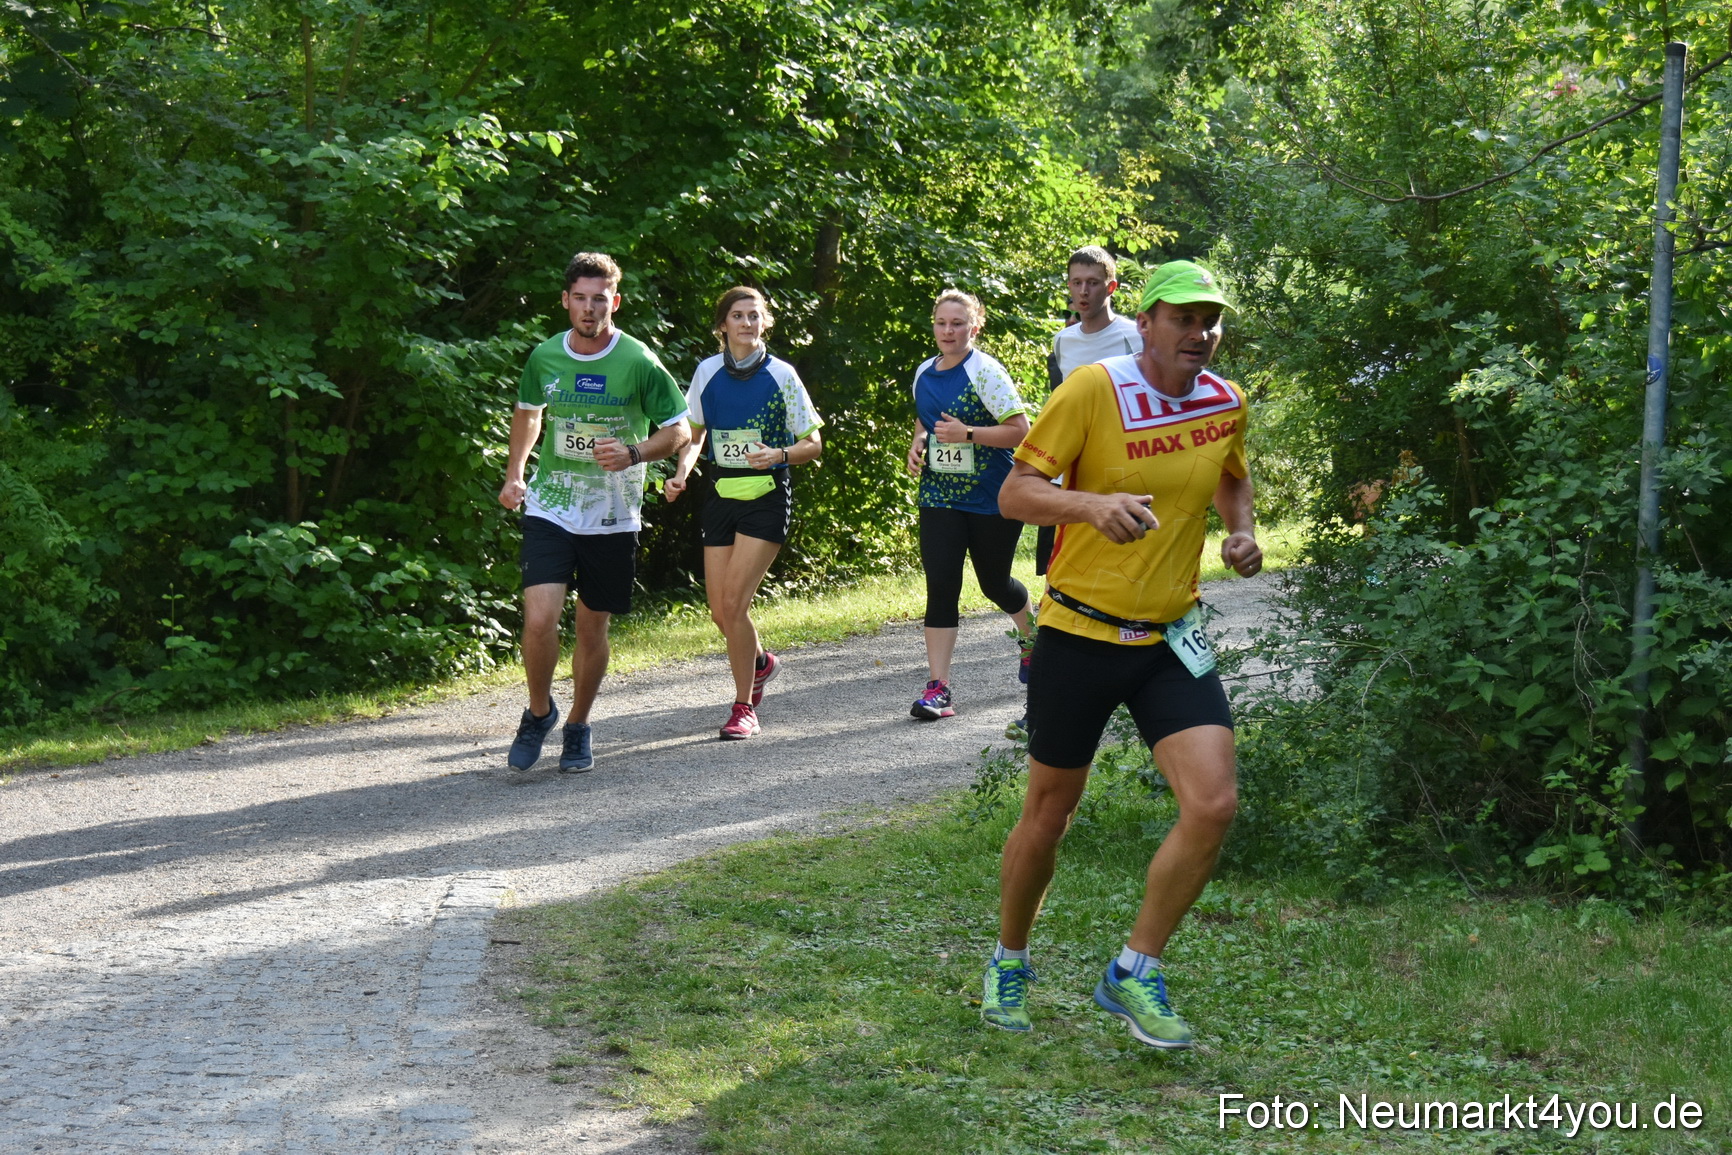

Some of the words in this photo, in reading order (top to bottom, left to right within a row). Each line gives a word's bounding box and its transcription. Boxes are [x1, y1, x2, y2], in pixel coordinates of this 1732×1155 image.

[578, 378, 604, 388] Fischer
[559, 389, 634, 406] firmenlauf
[587, 413, 625, 422] Firmen
[565, 434, 596, 451] 564
[1126, 434, 1186, 460] MAX
[722, 443, 751, 458] 234
[936, 448, 963, 463] 214
